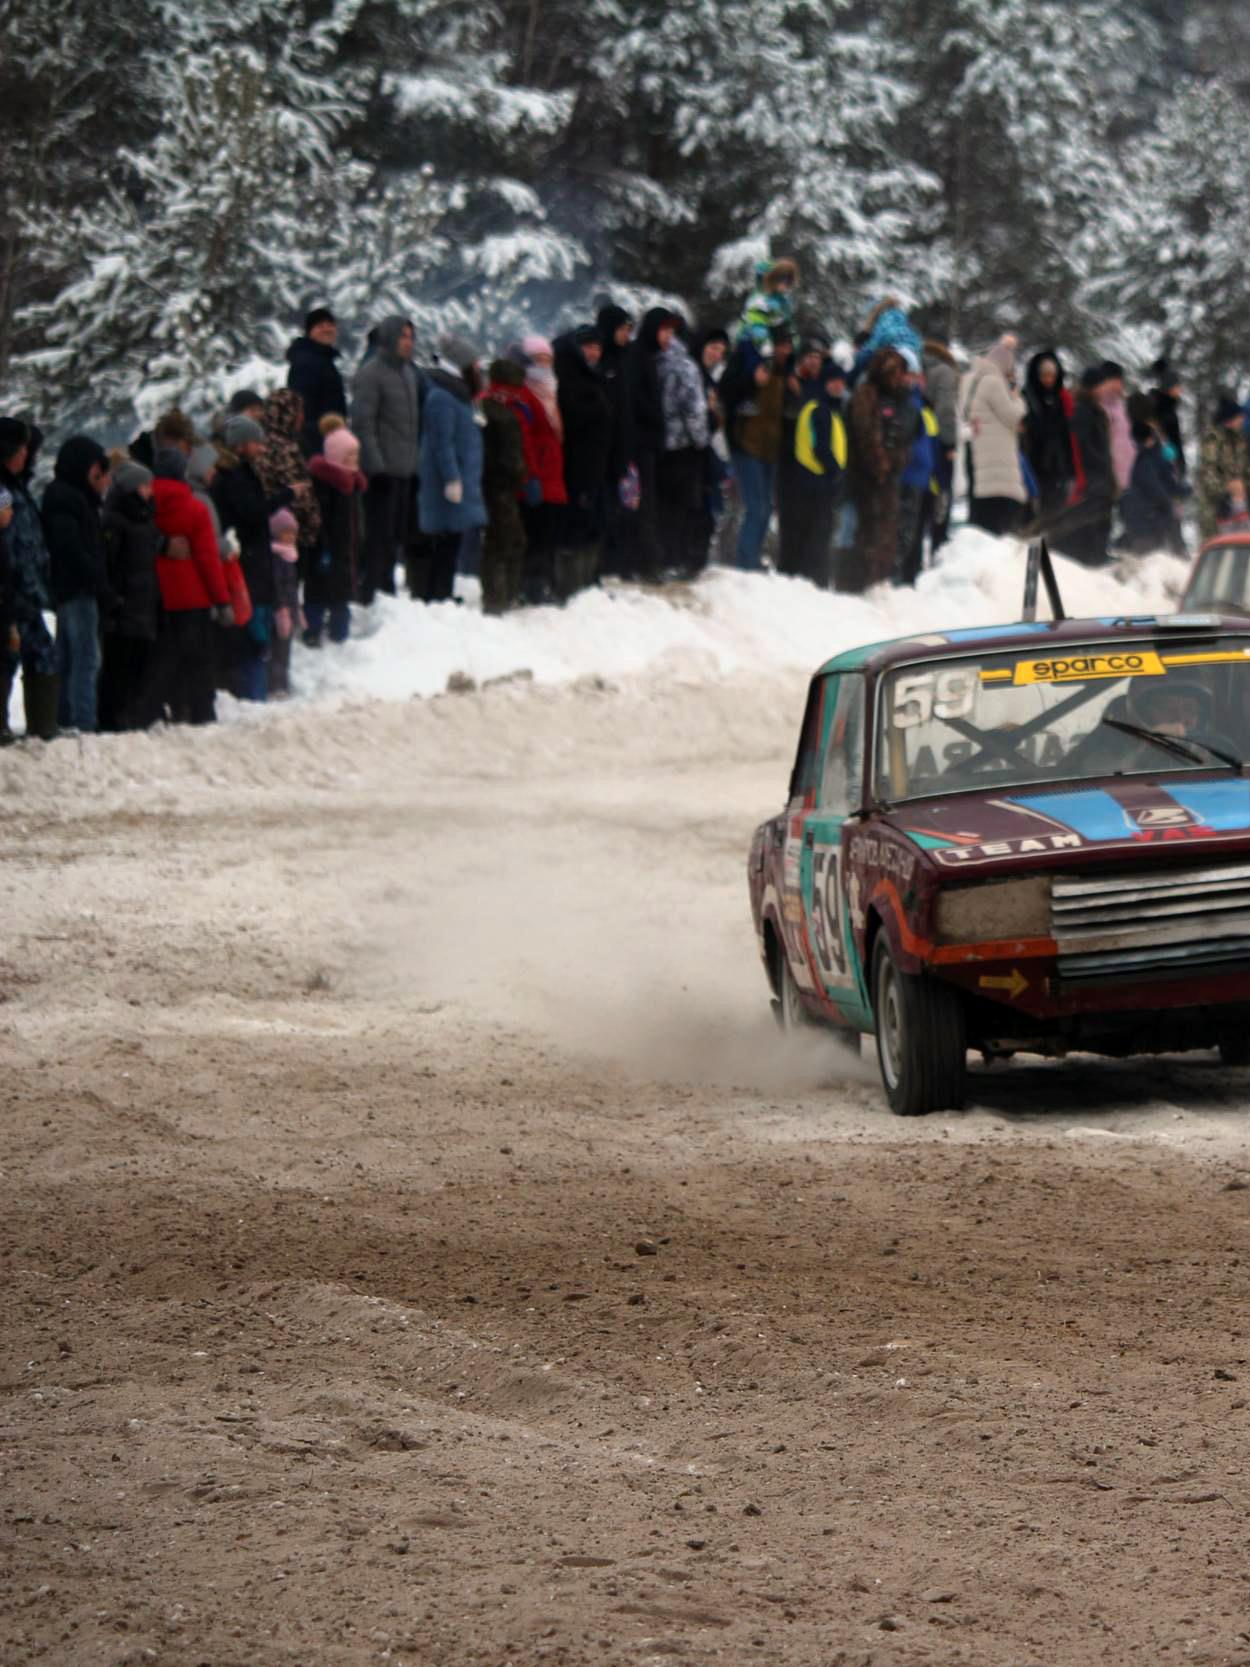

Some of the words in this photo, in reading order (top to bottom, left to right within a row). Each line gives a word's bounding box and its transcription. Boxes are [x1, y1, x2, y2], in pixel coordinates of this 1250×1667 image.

[1032, 655, 1144, 678] sparco
[893, 668, 976, 729] 59
[945, 832, 1083, 860] TEAM
